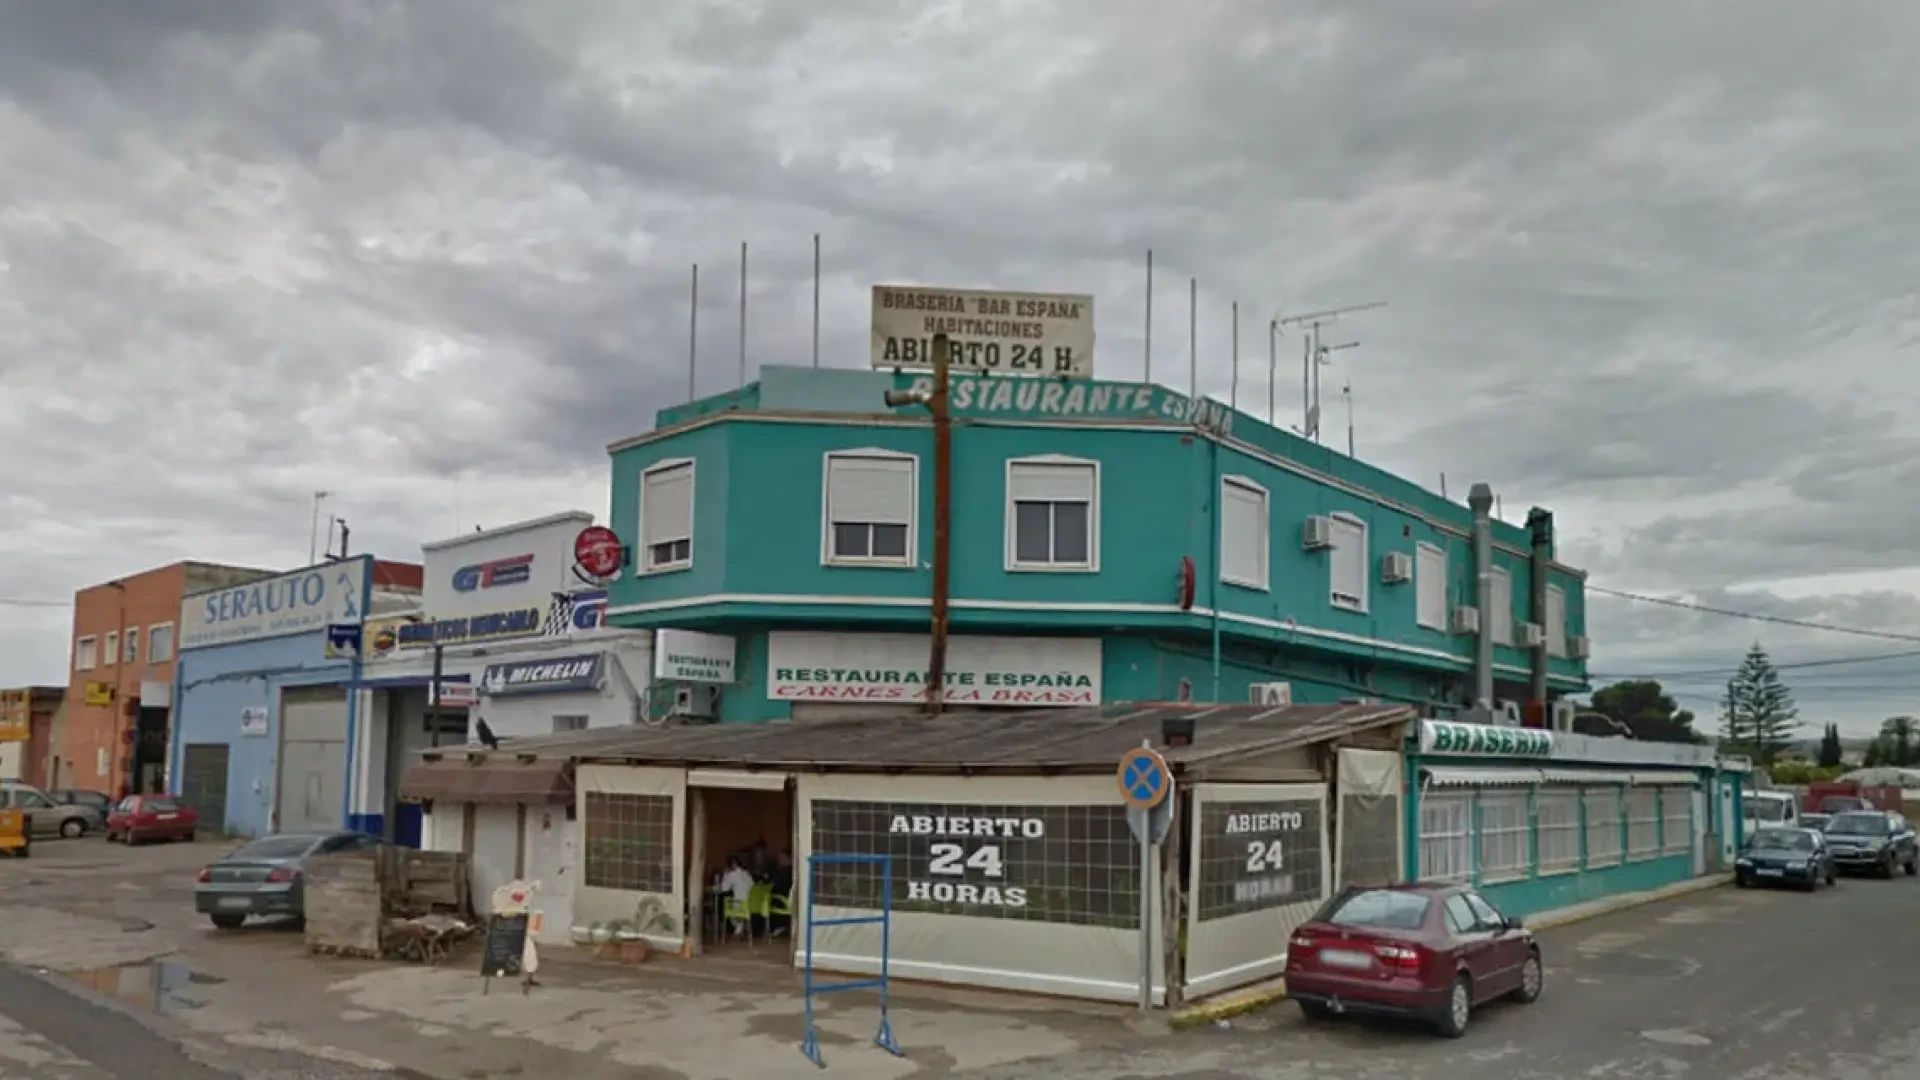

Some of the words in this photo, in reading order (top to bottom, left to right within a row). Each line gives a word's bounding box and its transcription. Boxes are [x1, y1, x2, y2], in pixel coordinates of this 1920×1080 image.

[883, 291, 964, 313] BRASERIA
[924, 316, 1043, 339] HABITACIONES
[883, 336, 999, 366] ABIRTO
[1011, 344, 1043, 370] 24
[1054, 346, 1079, 372] H.
[906, 377, 1153, 414] RSTAURANTE
[204, 573, 325, 624] SERAUTO
[509, 660, 593, 682] MICHELIN
[984, 671, 1092, 687] ESPAÑA
[776, 685, 904, 699] CARNES
[945, 687, 980, 700] LA
[991, 689, 1092, 703] BRASA
[1433, 723, 1551, 756] BRASERIA
[889, 814, 1044, 838] ABIERTO
[1226, 811, 1302, 833] ABIERTO
[929, 843, 1003, 877] 24
[1246, 839, 1283, 872] 24
[908, 881, 1027, 907] HORAS
